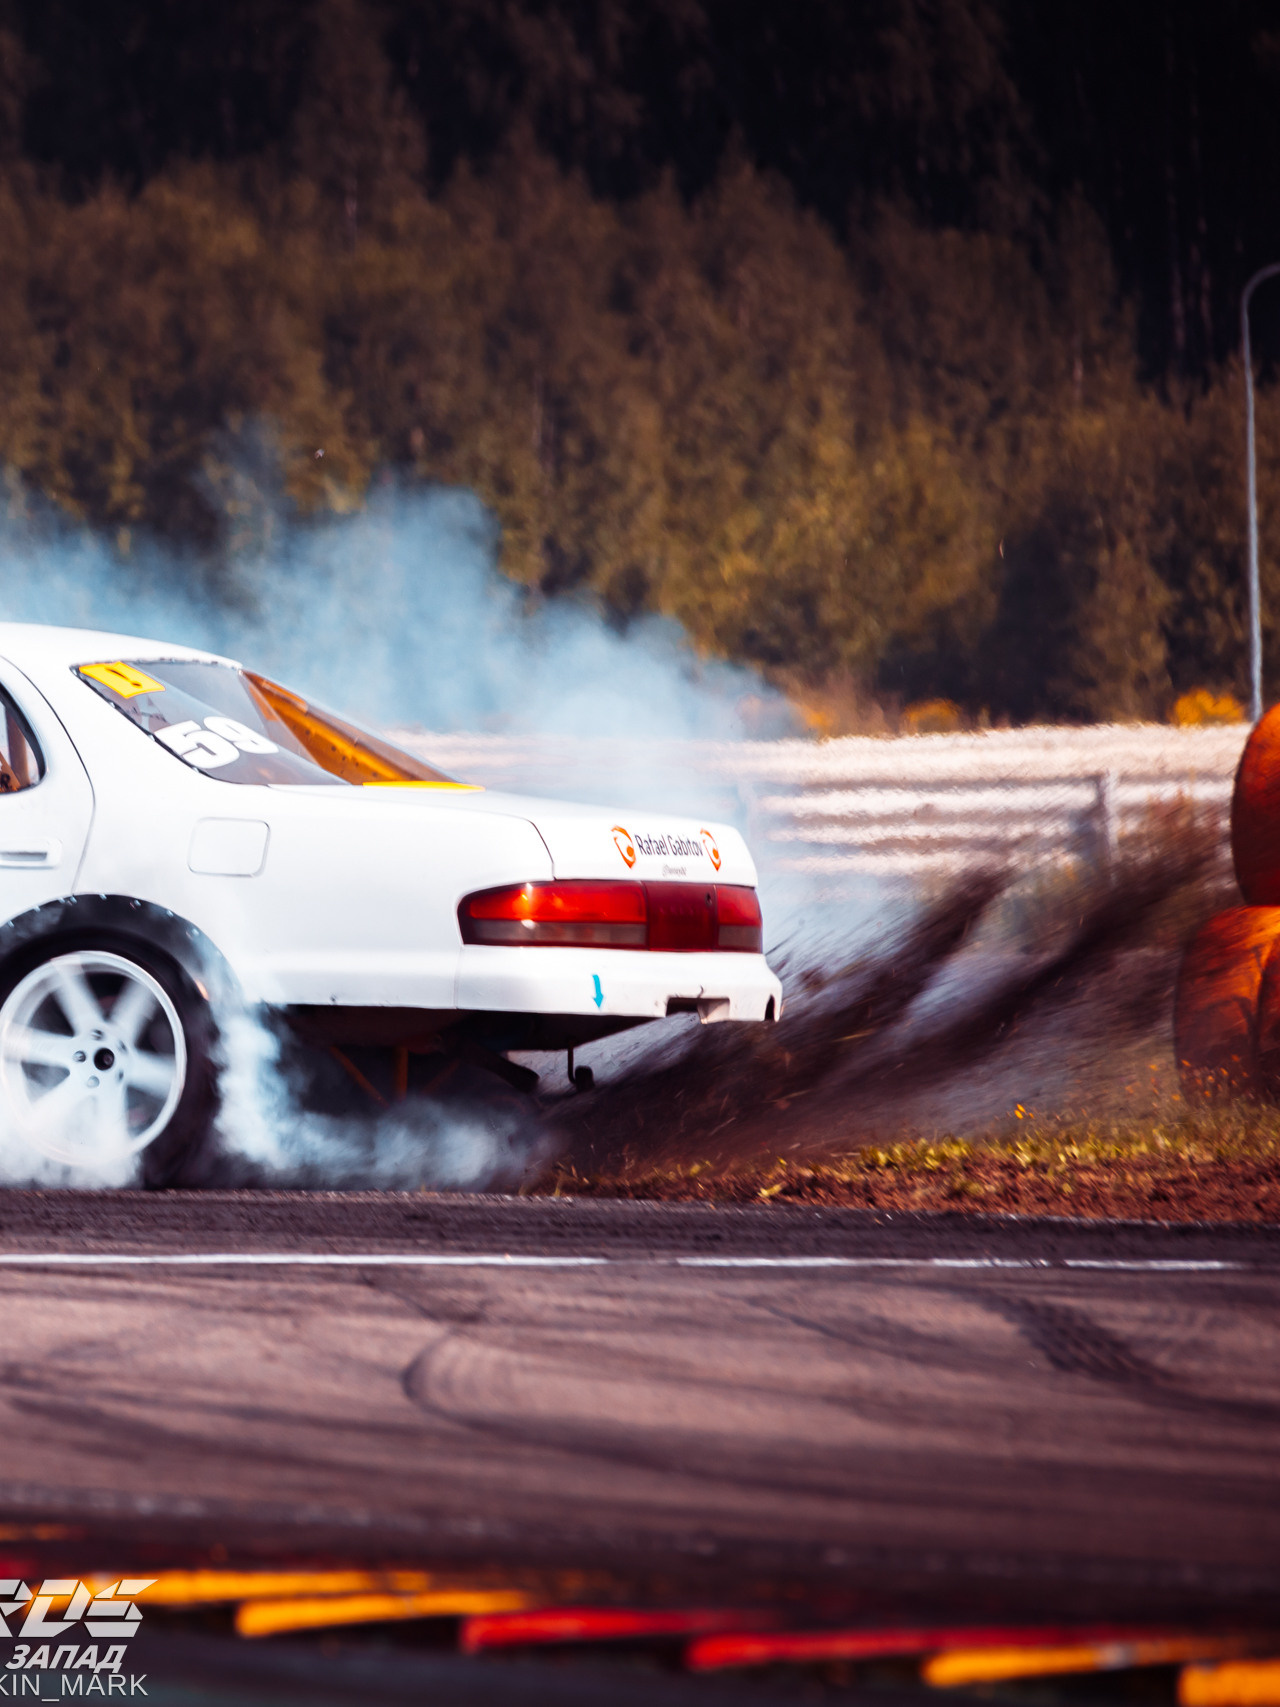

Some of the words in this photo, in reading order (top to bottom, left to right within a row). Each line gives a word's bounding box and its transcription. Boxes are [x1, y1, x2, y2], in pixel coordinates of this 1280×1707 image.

[153, 715, 279, 770] 59
[634, 833, 670, 857] Rafael
[666, 834, 704, 858] Gabitov
